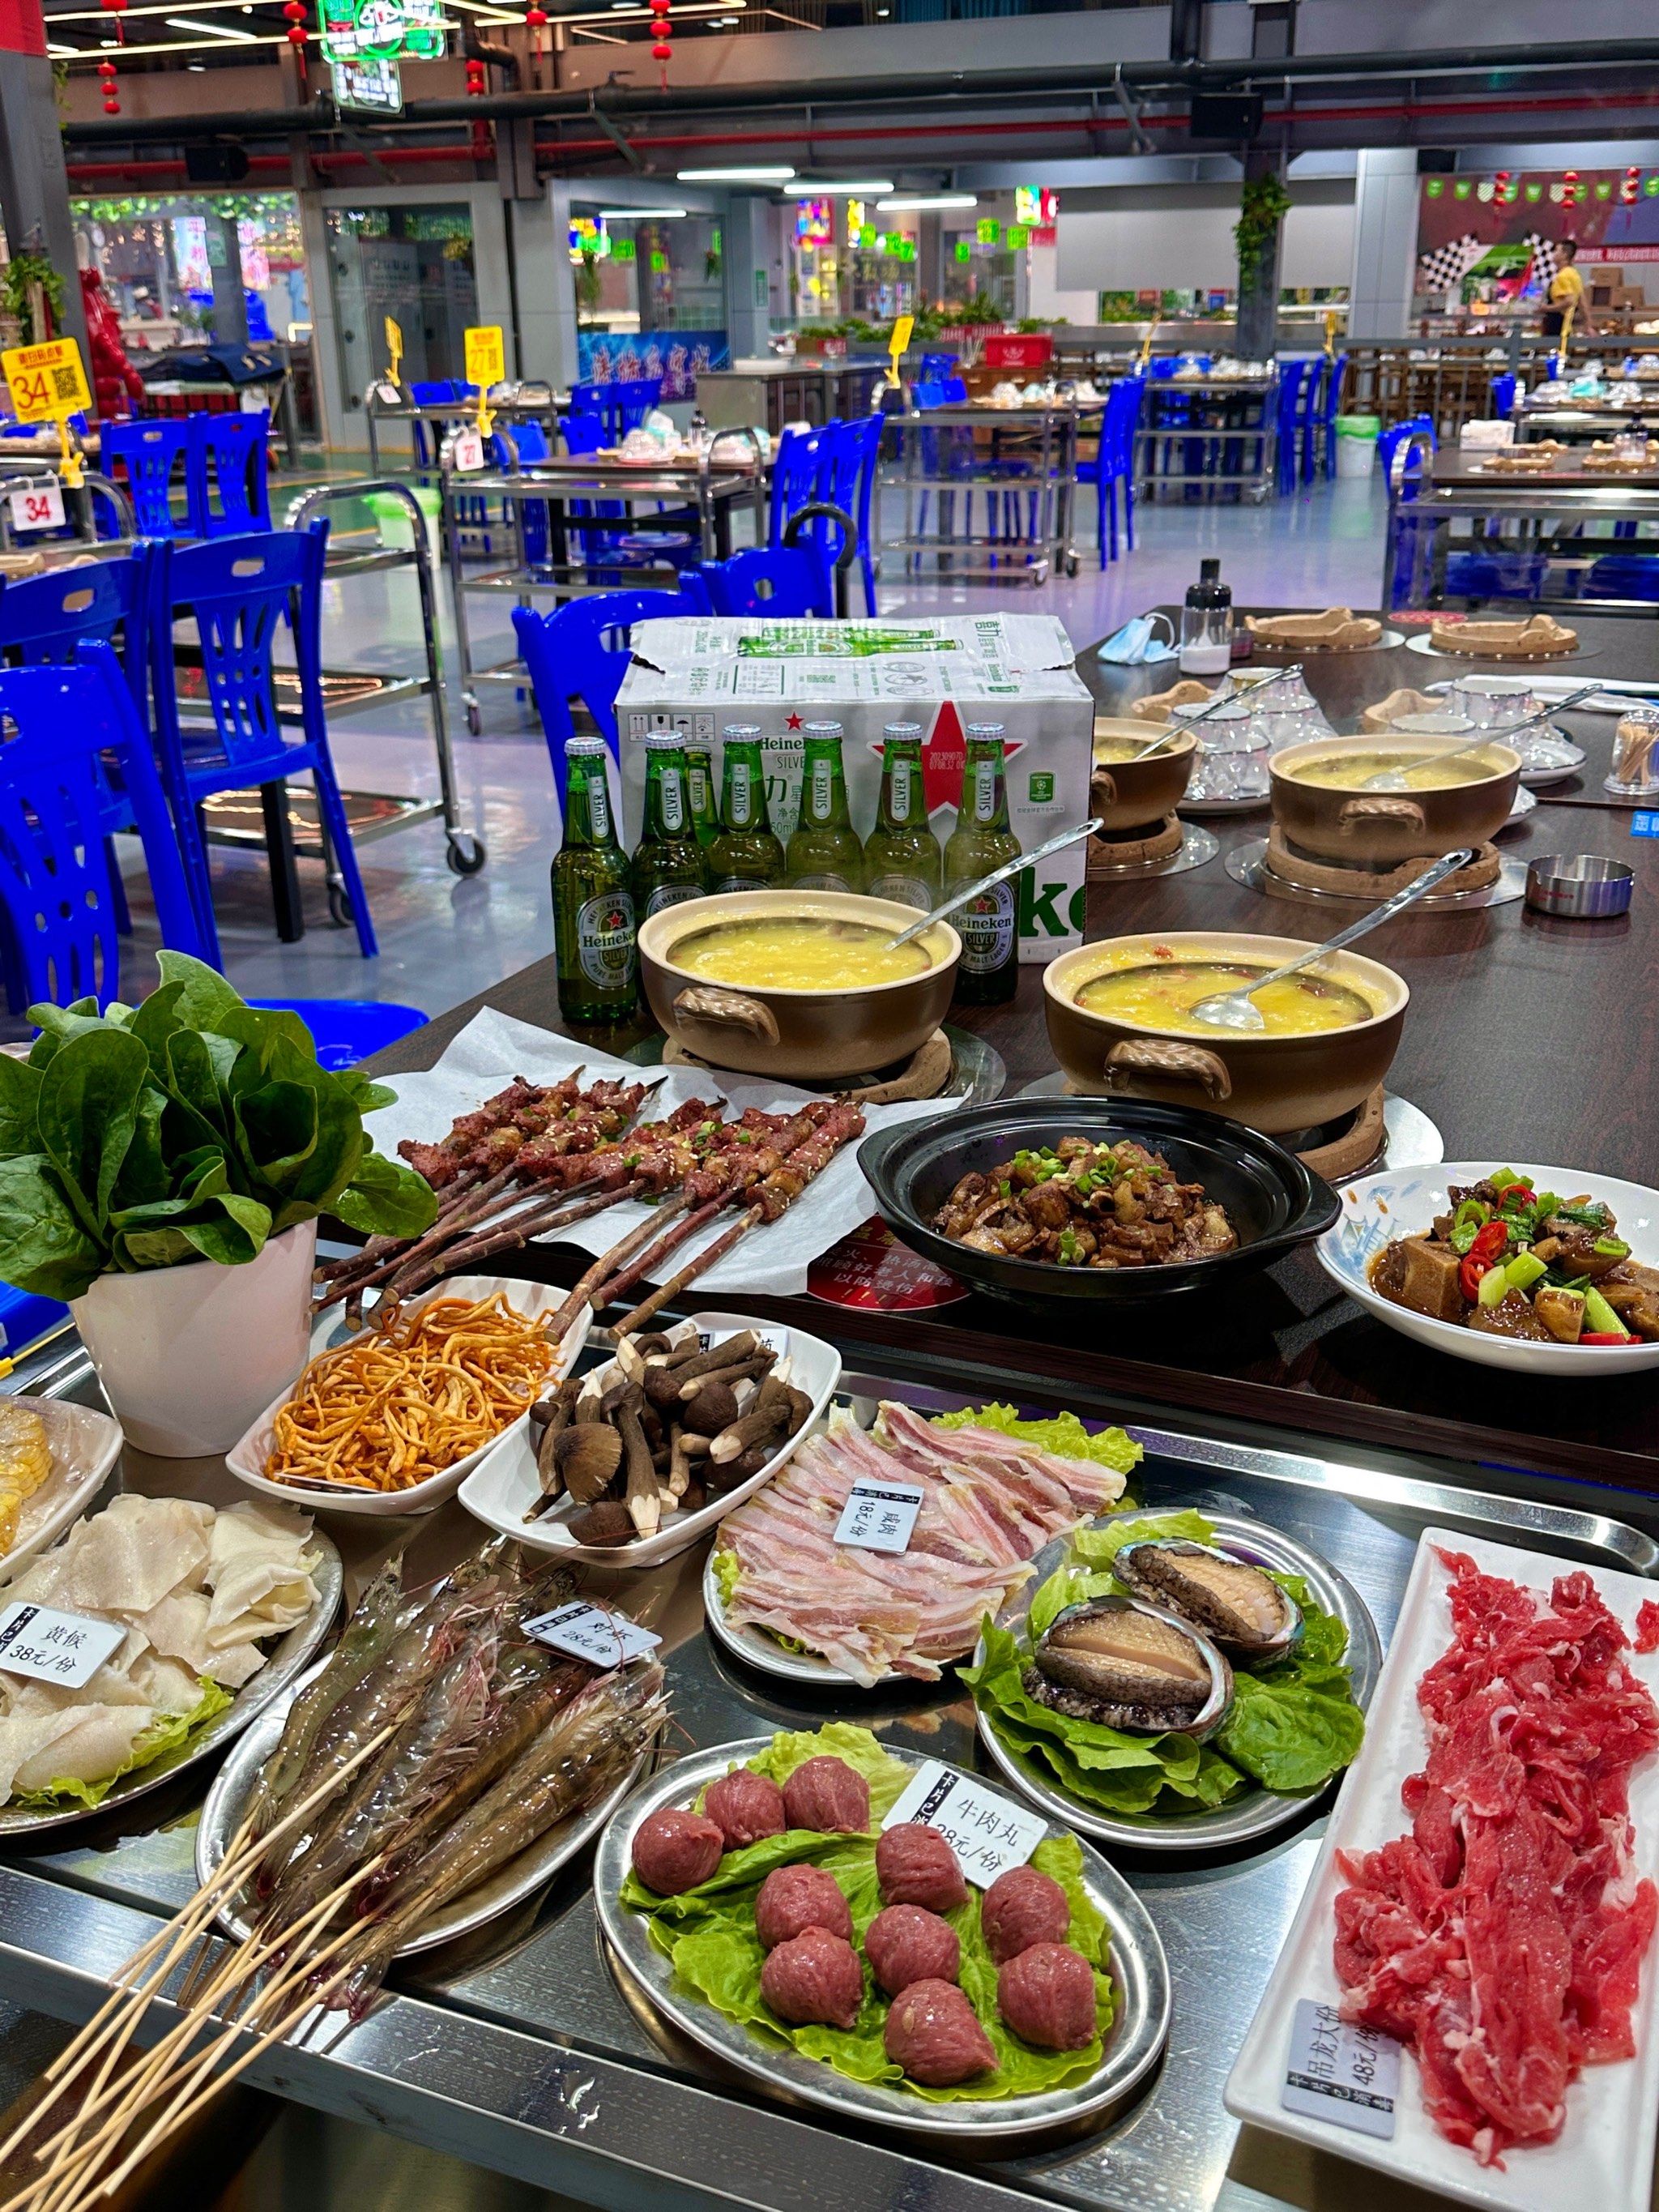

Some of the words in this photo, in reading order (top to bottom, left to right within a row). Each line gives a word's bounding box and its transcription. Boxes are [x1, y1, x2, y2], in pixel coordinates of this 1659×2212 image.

[13, 372, 50, 409] 34
[465, 444, 476, 464] 27
[26, 496, 51, 521] 34
[761, 737, 805, 750] Heine
[778, 757, 805, 769] SILVE
[667, 787, 679, 820] SILVER
[693, 781, 704, 805] SILVER
[736, 780, 747, 813] SILVER
[816, 776, 827, 809] SILVER
[894, 777, 906, 810] SILVER
[979, 778, 992, 811] SILVER
[595, 792, 606, 827] SILVER
[778, 807, 799, 820] 净含
[992, 886, 1009, 905] SILVER
[953, 916, 1012, 929] Heineken
[583, 929, 635, 947] Heineke
[967, 933, 996, 945] SILVER
[990, 942, 1007, 961] LAGER
[834, 1273, 916, 1295] 以防烫伤
[850, 1501, 876, 1536] 18元/份
[877, 1511, 902, 1535] 咸肉
[41, 1625, 88, 1650] 黄候
[561, 1630, 612, 1654] 28元/份
[588, 1622, 633, 1642] 对虾
[10, 1645, 77, 1673] 38元/份
[957, 1799, 1017, 1847] 牛肉丸
[1307, 2005, 1341, 2080] 吊龙大份
[1353, 2024, 1380, 2086] 48元/份
